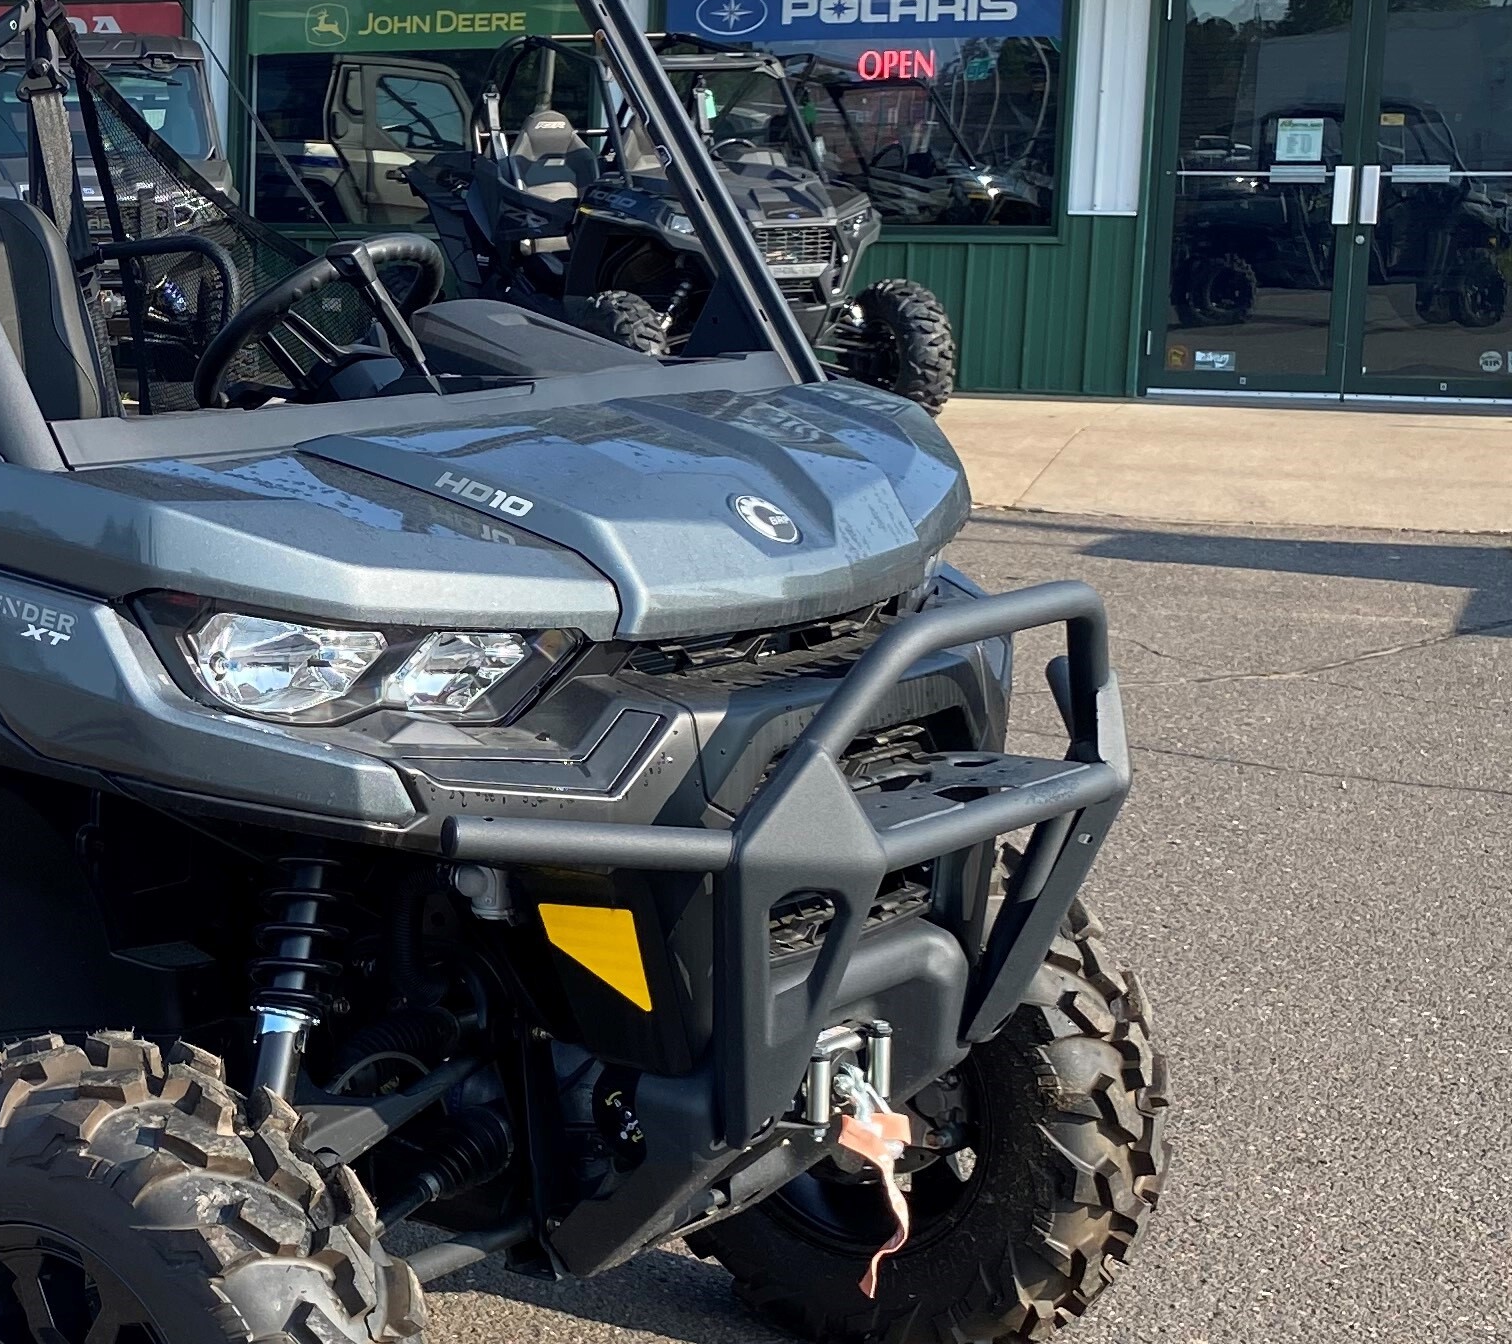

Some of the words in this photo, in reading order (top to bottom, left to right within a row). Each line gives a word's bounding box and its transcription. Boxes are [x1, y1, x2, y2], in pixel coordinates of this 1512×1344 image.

[435, 10, 527, 34] DEERE
[857, 48, 936, 81] OPEN
[433, 470, 535, 518] HD10
[20, 623, 72, 647] XT
